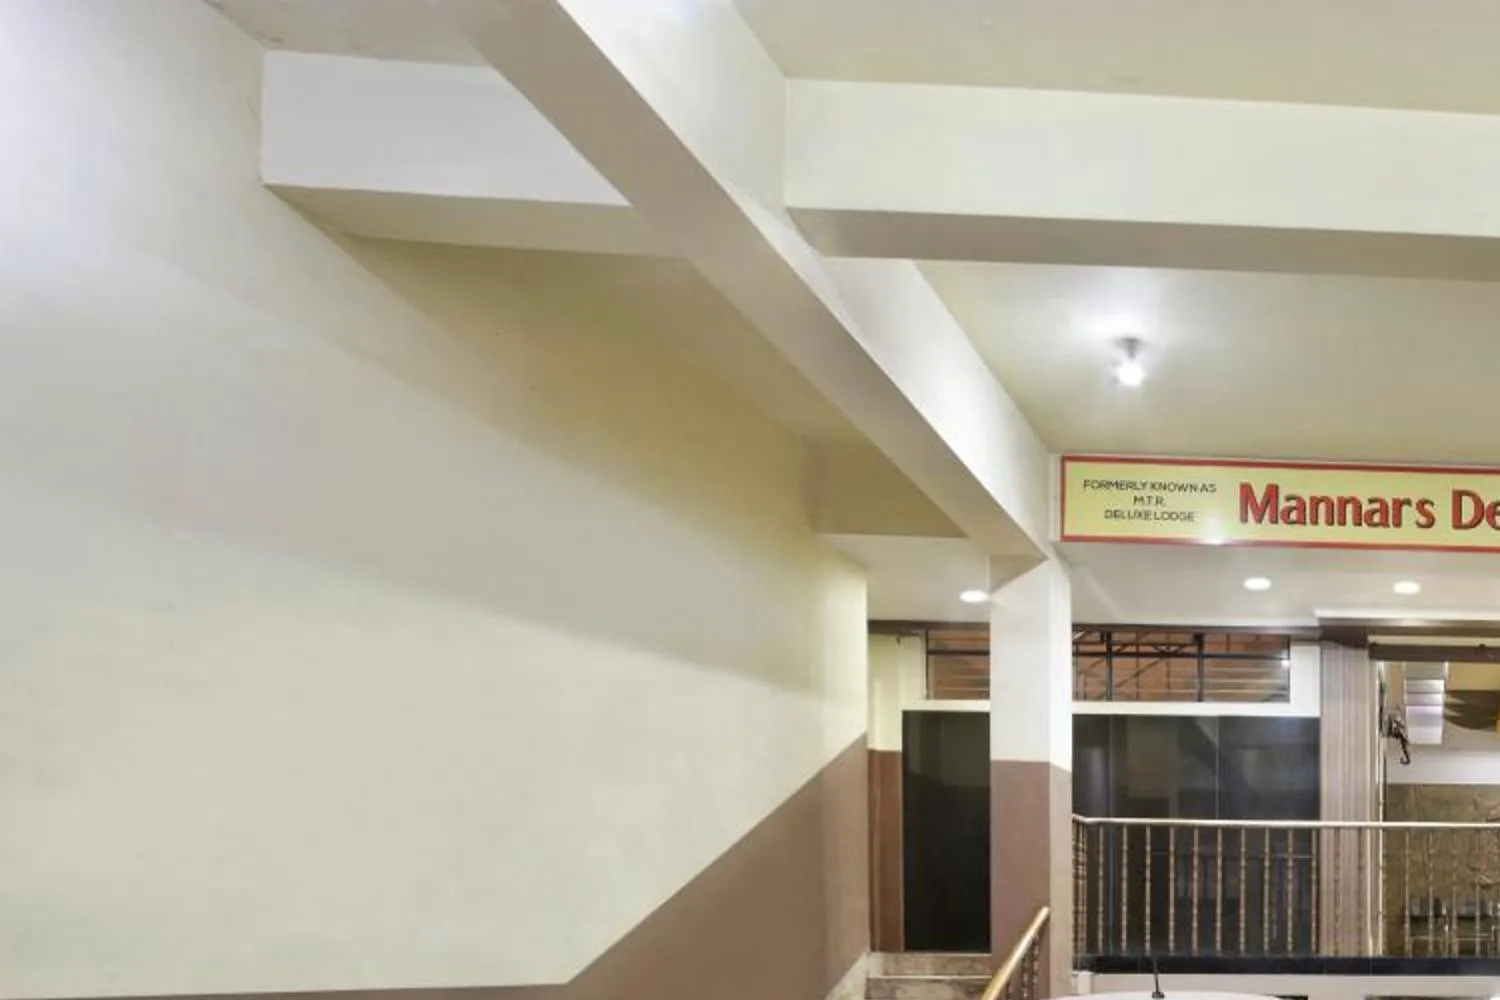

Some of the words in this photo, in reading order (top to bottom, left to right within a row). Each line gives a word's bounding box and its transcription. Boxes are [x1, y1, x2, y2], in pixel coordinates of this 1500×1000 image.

[1082, 479, 1147, 492] FORMERLY
[1150, 481, 1197, 493] KNOWN
[1199, 483, 1217, 493] AS
[1238, 481, 1436, 529] Mannars
[1103, 509, 1152, 520] DELUXE
[1153, 511, 1195, 522] LODGE
